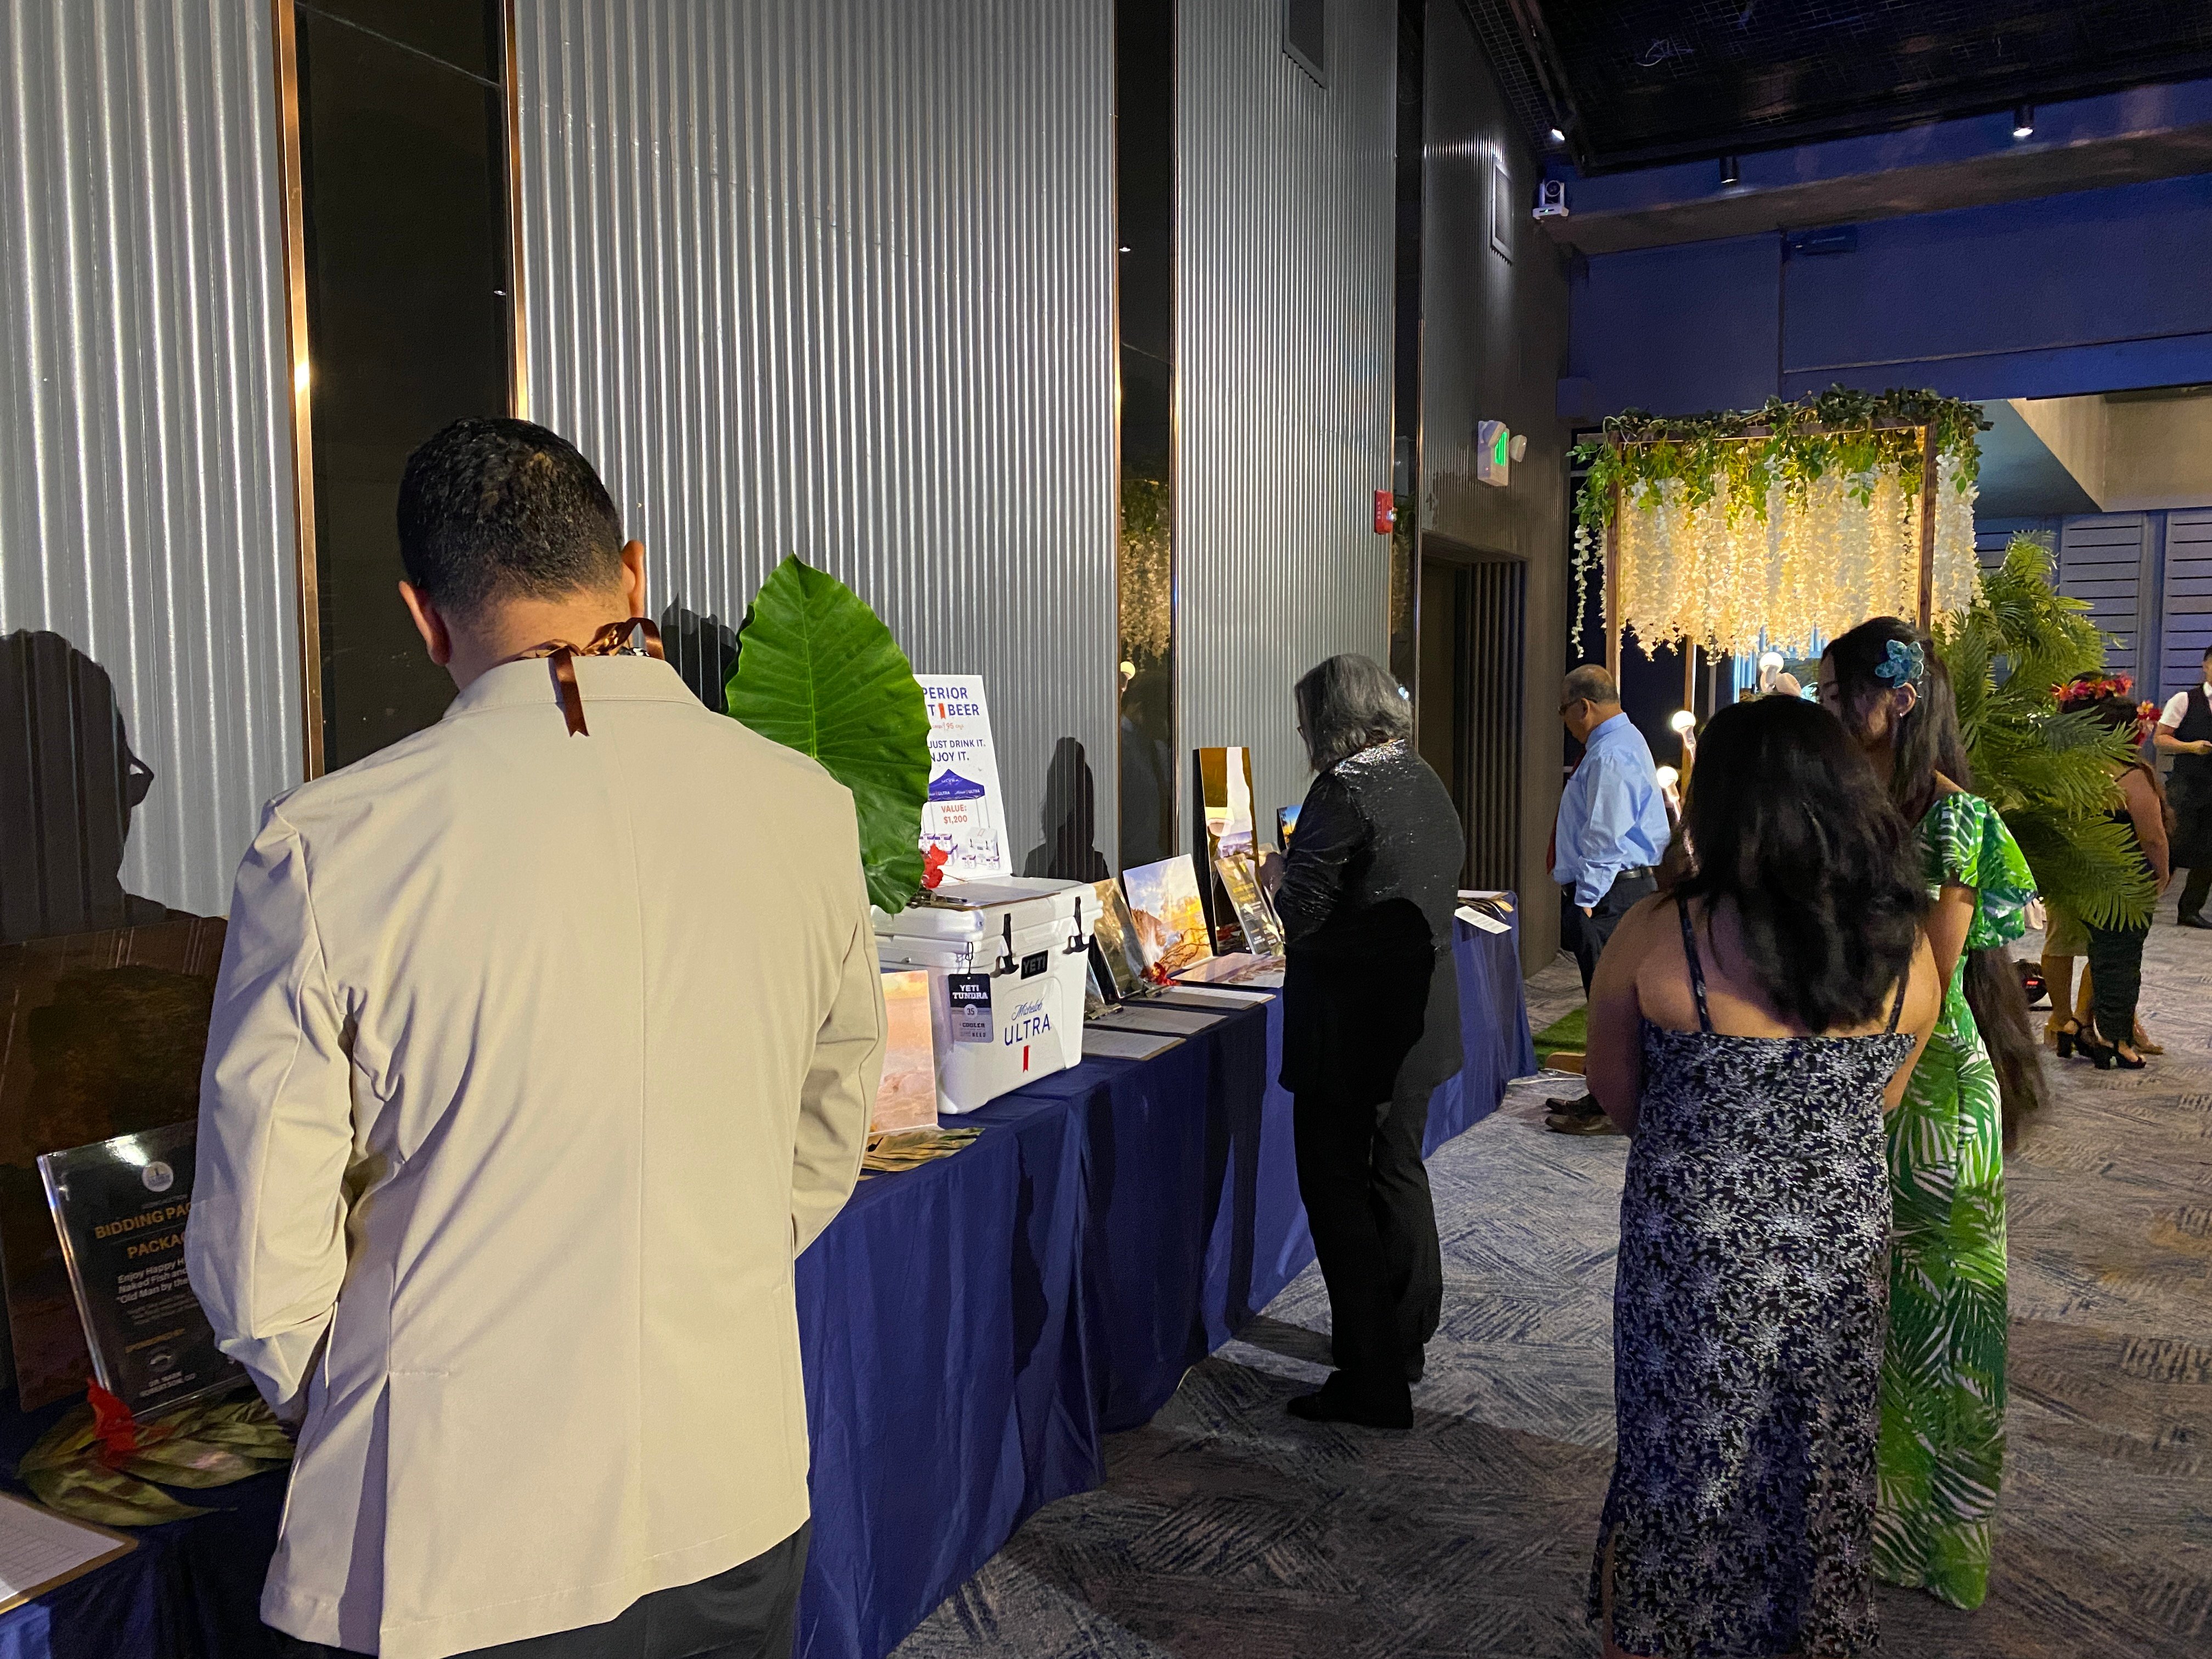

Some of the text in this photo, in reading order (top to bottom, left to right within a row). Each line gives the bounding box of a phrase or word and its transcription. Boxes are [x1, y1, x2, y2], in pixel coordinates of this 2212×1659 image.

[947, 704, 980, 716] BEER
[928, 739, 986, 748] JUST DRINK IT.
[958, 751, 969, 761] IT.
[941, 804, 967, 813] VALUE:
[944, 815, 967, 824] $1,200
[1023, 956, 1046, 974] YETI
[1011, 999, 1043, 1021] Michelob
[1005, 1014, 1051, 1046] ULTRA
[95, 1210, 164, 1239] BIDDING
[117, 1270, 145, 1284] Enjoy
[146, 1261, 176, 1275] Happy
[119, 1277, 150, 1294] Naked
[151, 1272, 171, 1283] Fish
[139, 1286, 160, 1298] Man
[161, 1282, 173, 1291] by
